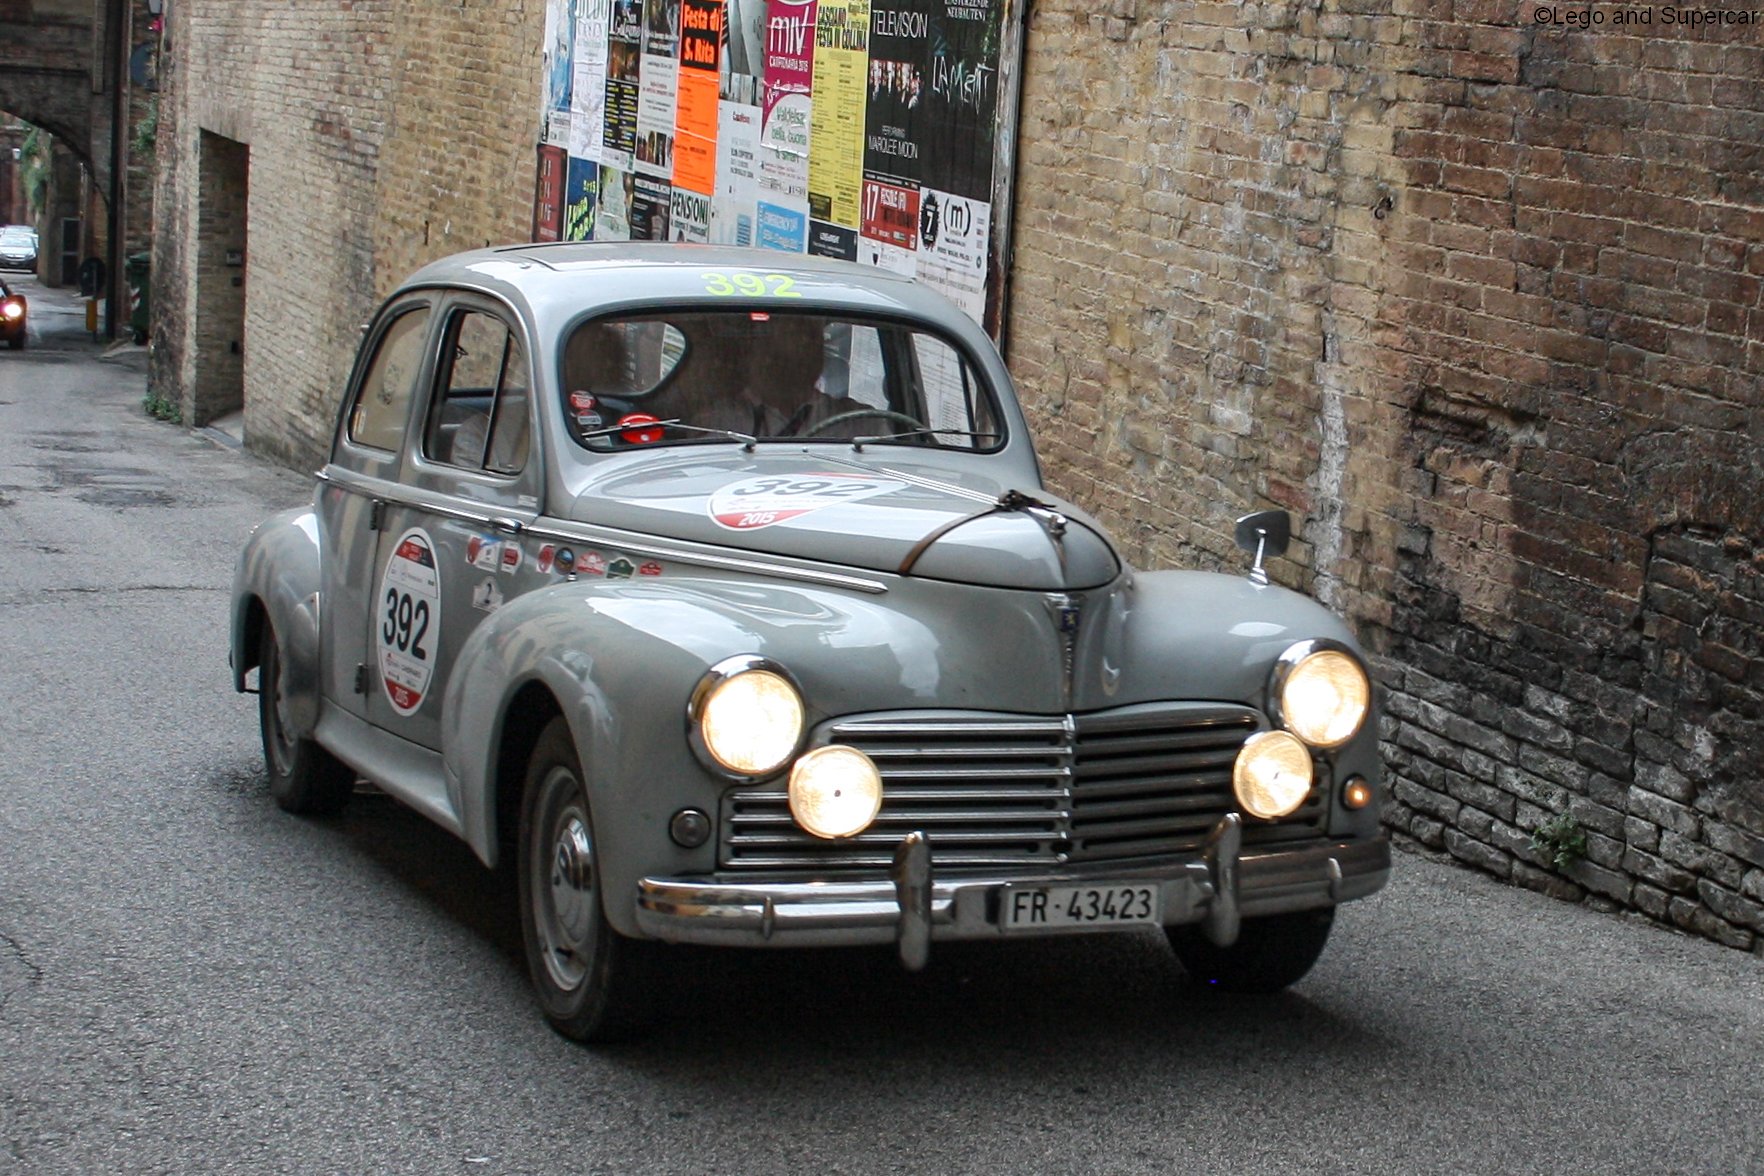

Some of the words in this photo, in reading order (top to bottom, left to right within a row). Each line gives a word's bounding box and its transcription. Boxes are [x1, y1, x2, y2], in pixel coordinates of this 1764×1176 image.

[684, 4, 709, 30] Festa
[709, 8, 720, 32] di
[684, 37, 694, 60] S.
[695, 38, 715, 64] Rita
[671, 191, 709, 225] PENSIONI
[867, 184, 879, 222] 17
[926, 210, 934, 233] 7
[701, 272, 802, 298] 392
[733, 479, 878, 498] 392
[738, 511, 779, 526] 2015
[383, 587, 430, 661] 392
